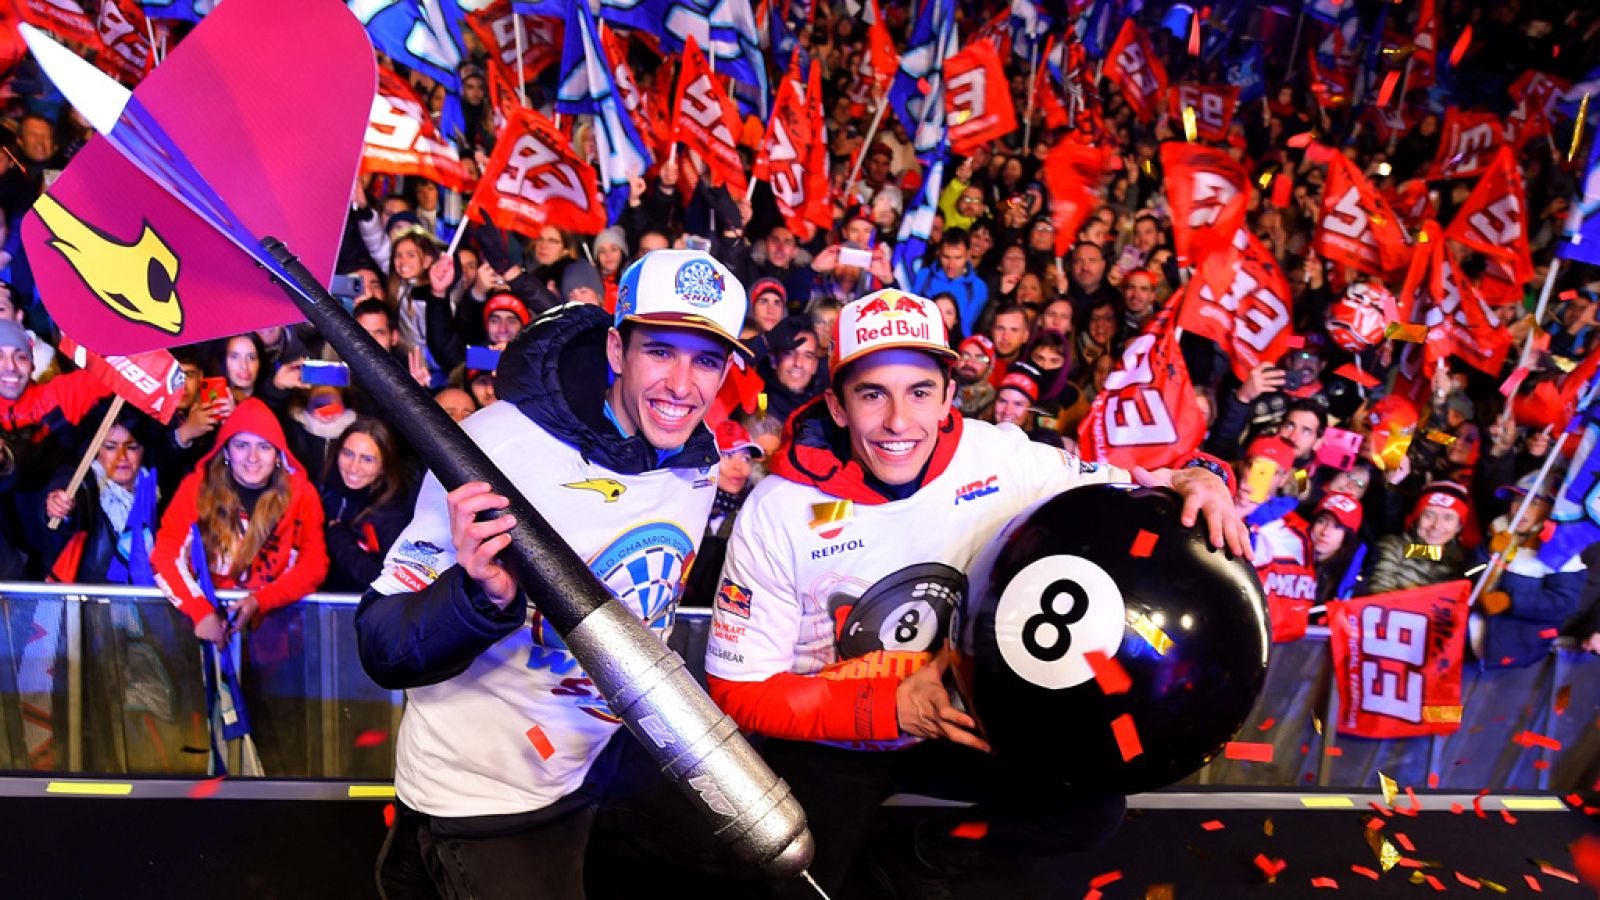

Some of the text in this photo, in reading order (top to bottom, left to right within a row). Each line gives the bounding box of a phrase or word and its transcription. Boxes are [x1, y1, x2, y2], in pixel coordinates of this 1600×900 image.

[856, 319, 929, 344] Red Bull
[954, 475, 1000, 506] HRC
[811, 538, 864, 559] REPSOL
[895, 609, 920, 642] 8
[1022, 579, 1089, 662] 8
[1361, 605, 1429, 724] 93
